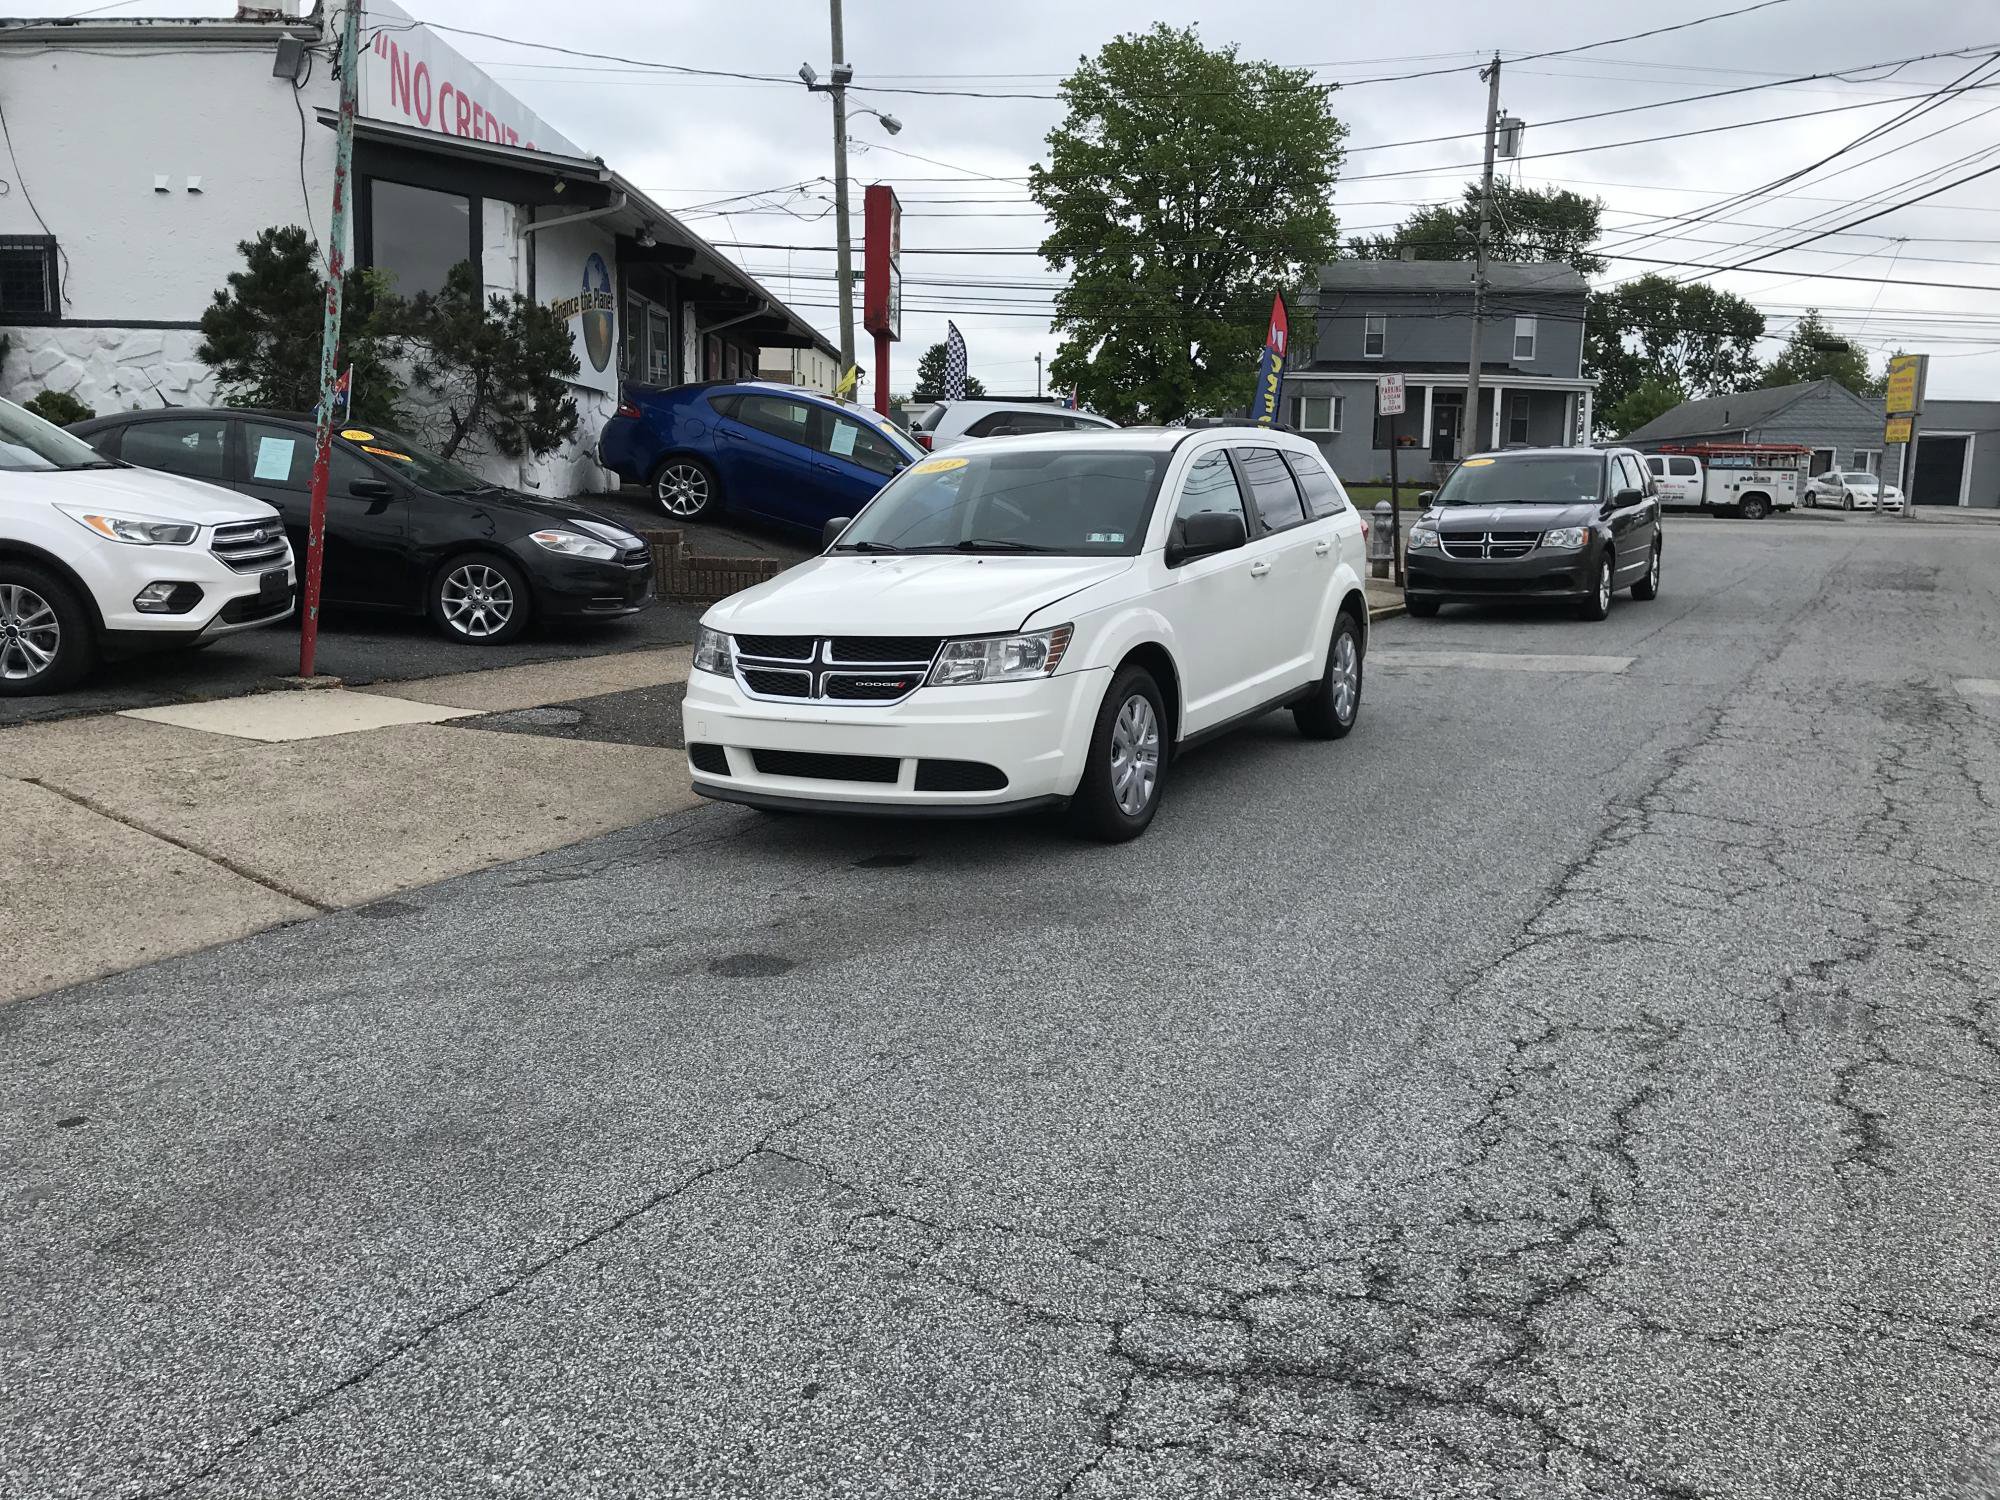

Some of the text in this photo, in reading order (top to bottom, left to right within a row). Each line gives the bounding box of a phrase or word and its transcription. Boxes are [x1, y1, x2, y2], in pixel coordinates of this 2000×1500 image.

[551, 287, 614, 319] Finance the Planet
[1387, 377, 1396, 385] NO
[1382, 385, 1402, 393] PARKING
